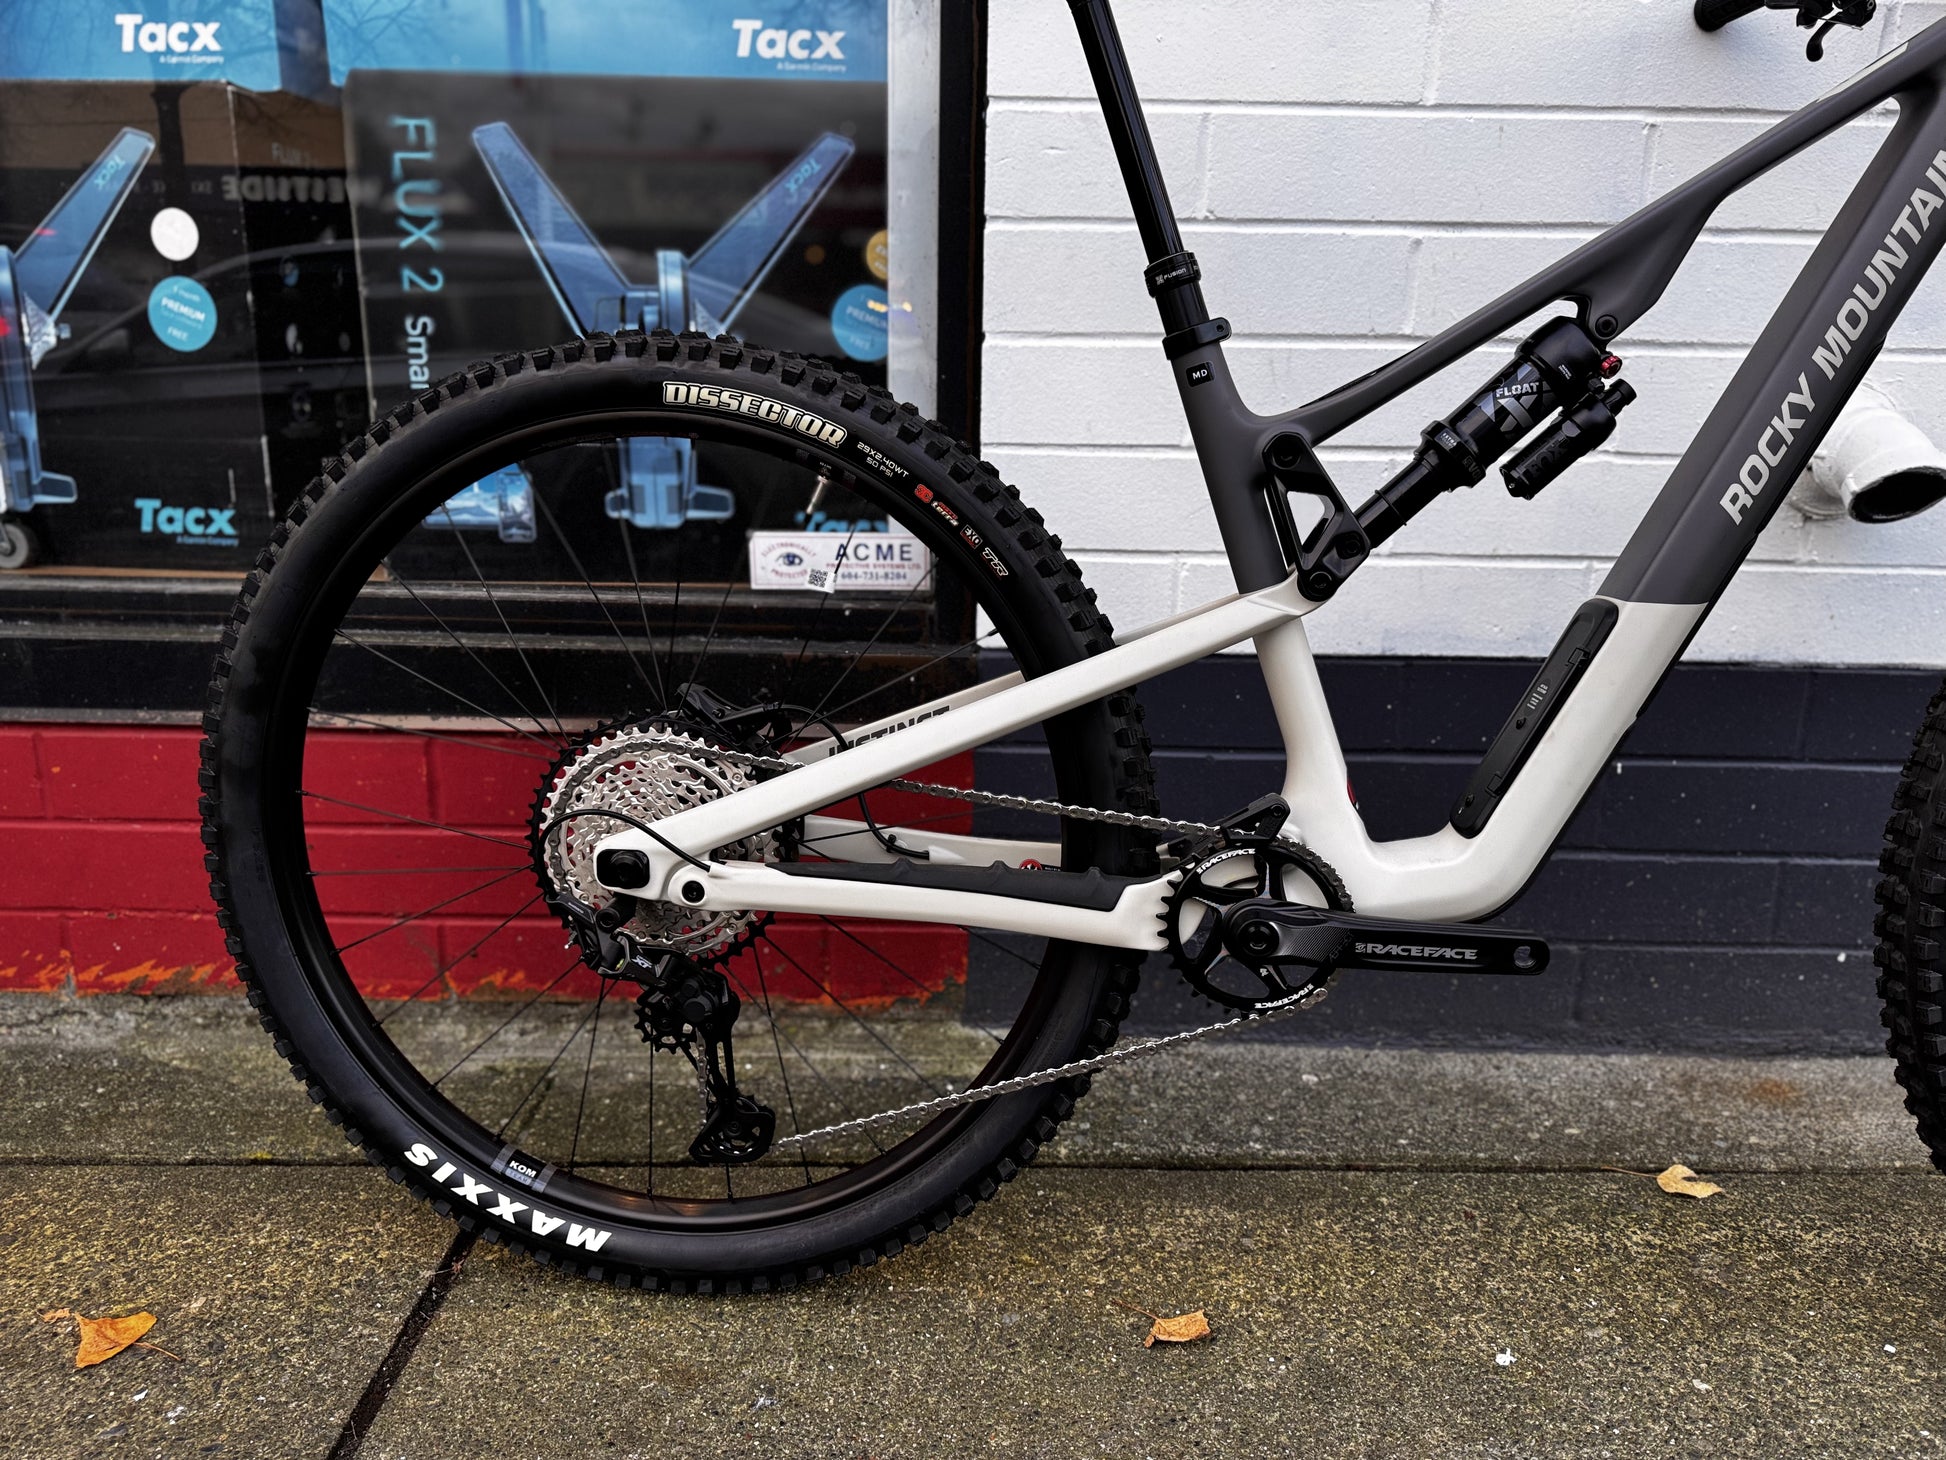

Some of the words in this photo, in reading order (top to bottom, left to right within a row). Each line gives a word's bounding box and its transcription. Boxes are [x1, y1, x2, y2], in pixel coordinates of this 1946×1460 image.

[115, 13, 222, 53] Tacx
[731, 18, 847, 60] Tacx
[389, 116, 443, 251] FLUX
[784, 157, 822, 193] Tacx
[400, 265, 445, 293] 2
[161, 296, 206, 323] PREMIUM
[1192, 367, 1208, 380] MD
[1495, 382, 1539, 398] FLOAT
[663, 382, 848, 448] DISSECTOR
[856, 441, 909, 478] 29X2.40WT
[1719, 372, 1817, 526] ROCKY
[866, 456, 879, 469] 50
[879, 463, 893, 478] PSI
[134, 497, 237, 535] Tacx
[826, 562, 870, 570] PRTECTIVE
[873, 562, 906, 570] SYSTEMS
[835, 543, 913, 561] ACME
[962, 526, 982, 547] EXO
[982, 547, 1009, 576] TR
[771, 568, 808, 579] PROTECTED
[1366, 943, 1479, 960] RACEFACE
[509, 1160, 537, 1178] KOM
[404, 1143, 612, 1252] MAXXIS
